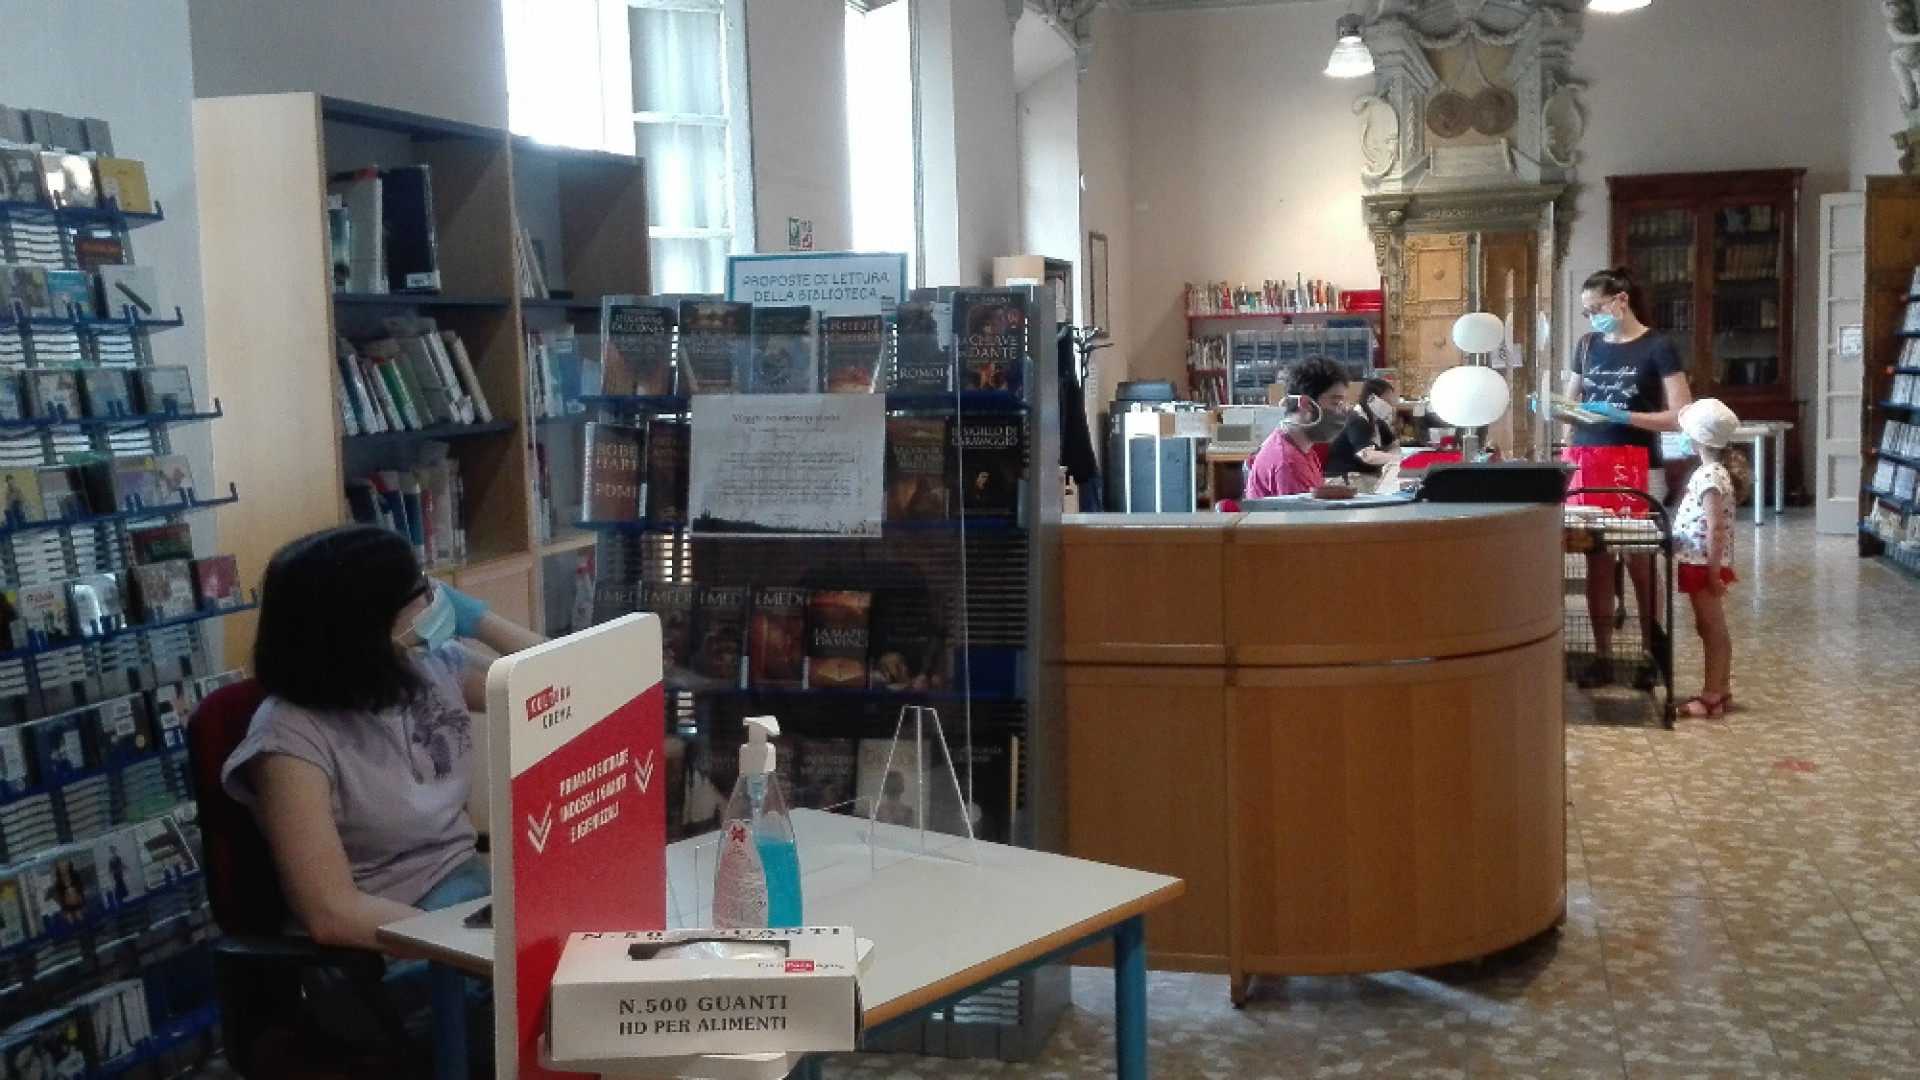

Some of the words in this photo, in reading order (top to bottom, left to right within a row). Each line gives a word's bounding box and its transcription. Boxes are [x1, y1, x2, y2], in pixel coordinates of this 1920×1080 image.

[742, 273, 812, 287] PROPOSTE
[813, 272, 829, 285] DI
[832, 271, 890, 284] LETTURA
[753, 290, 795, 302] DELLA
[799, 287, 878, 301] BIBLIOTECA
[970, 346, 1018, 359] DANTE
[542, 705, 573, 730] CREMA
[559, 769, 587, 797] PRIMA
[560, 790, 597, 822] INDOSSA
[600, 772, 627, 801] GUANTI
[619, 997, 688, 1015] N.500
[697, 995, 789, 1012] GUANTI
[619, 1020, 648, 1036] HD
[653, 1019, 691, 1034] PER
[696, 1016, 788, 1032] ALIMENTI
